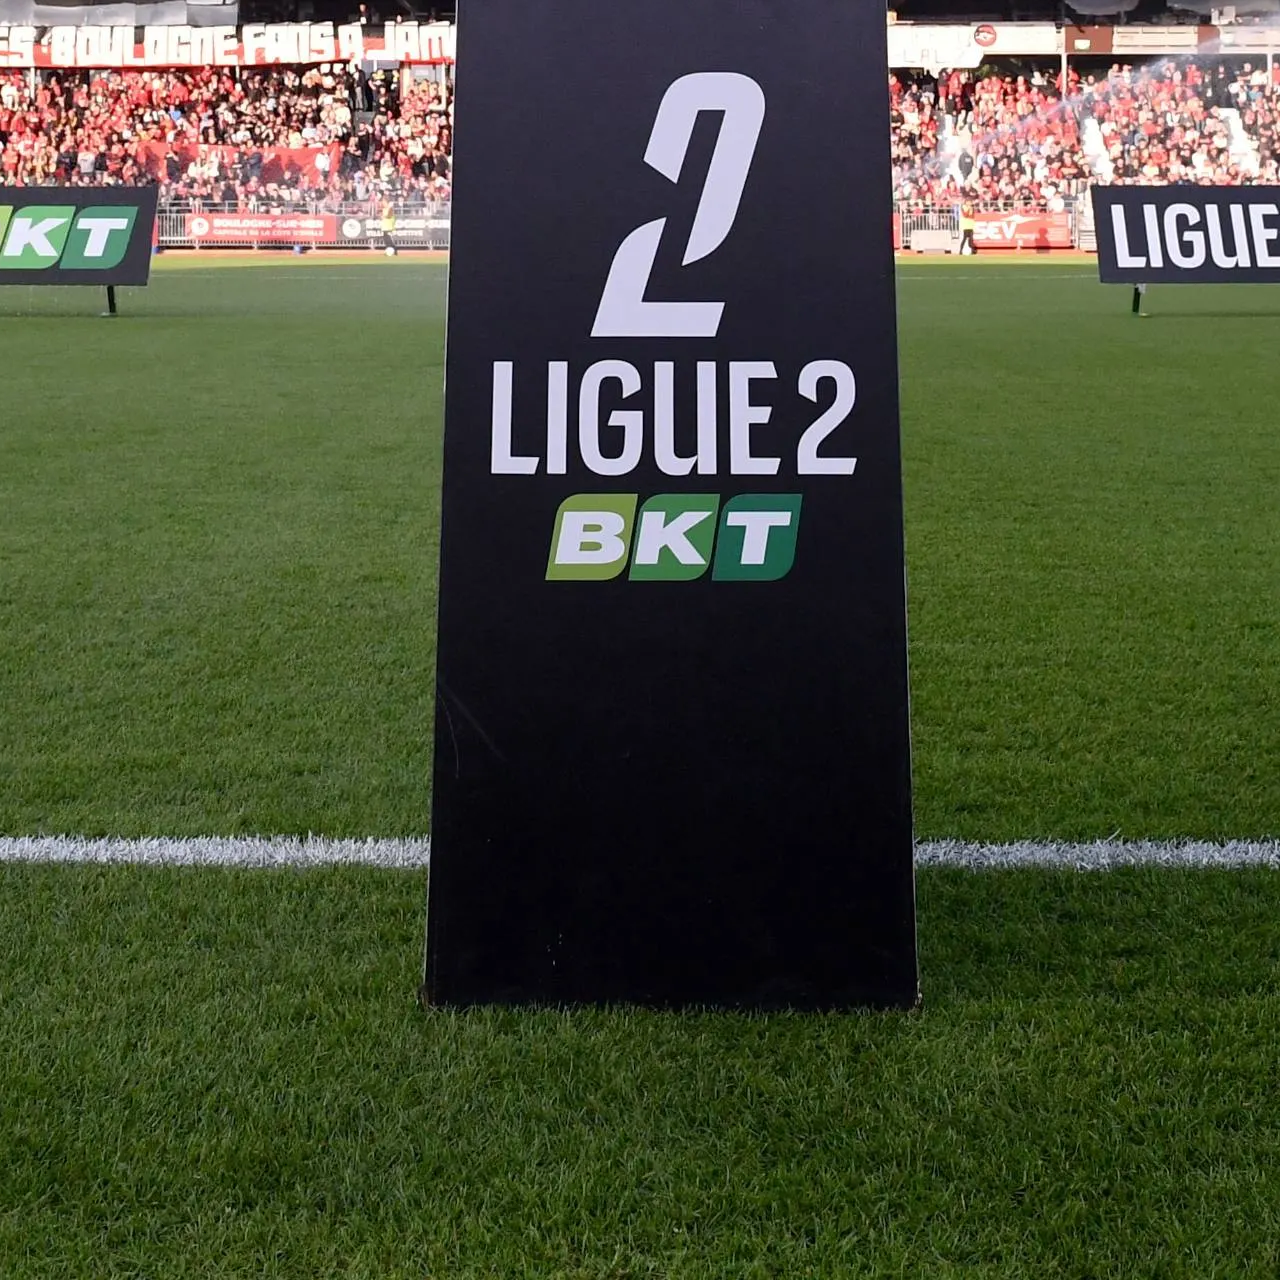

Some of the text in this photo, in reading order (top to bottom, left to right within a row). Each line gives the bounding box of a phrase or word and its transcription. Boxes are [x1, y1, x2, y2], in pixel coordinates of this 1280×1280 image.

[52, 26, 238, 66] BOULOGNE
[366, 22, 457, 62] JAM
[591, 72, 766, 337] 2
[491, 359, 858, 476] LIGUE 2
[555, 511, 792, 565] BKT
